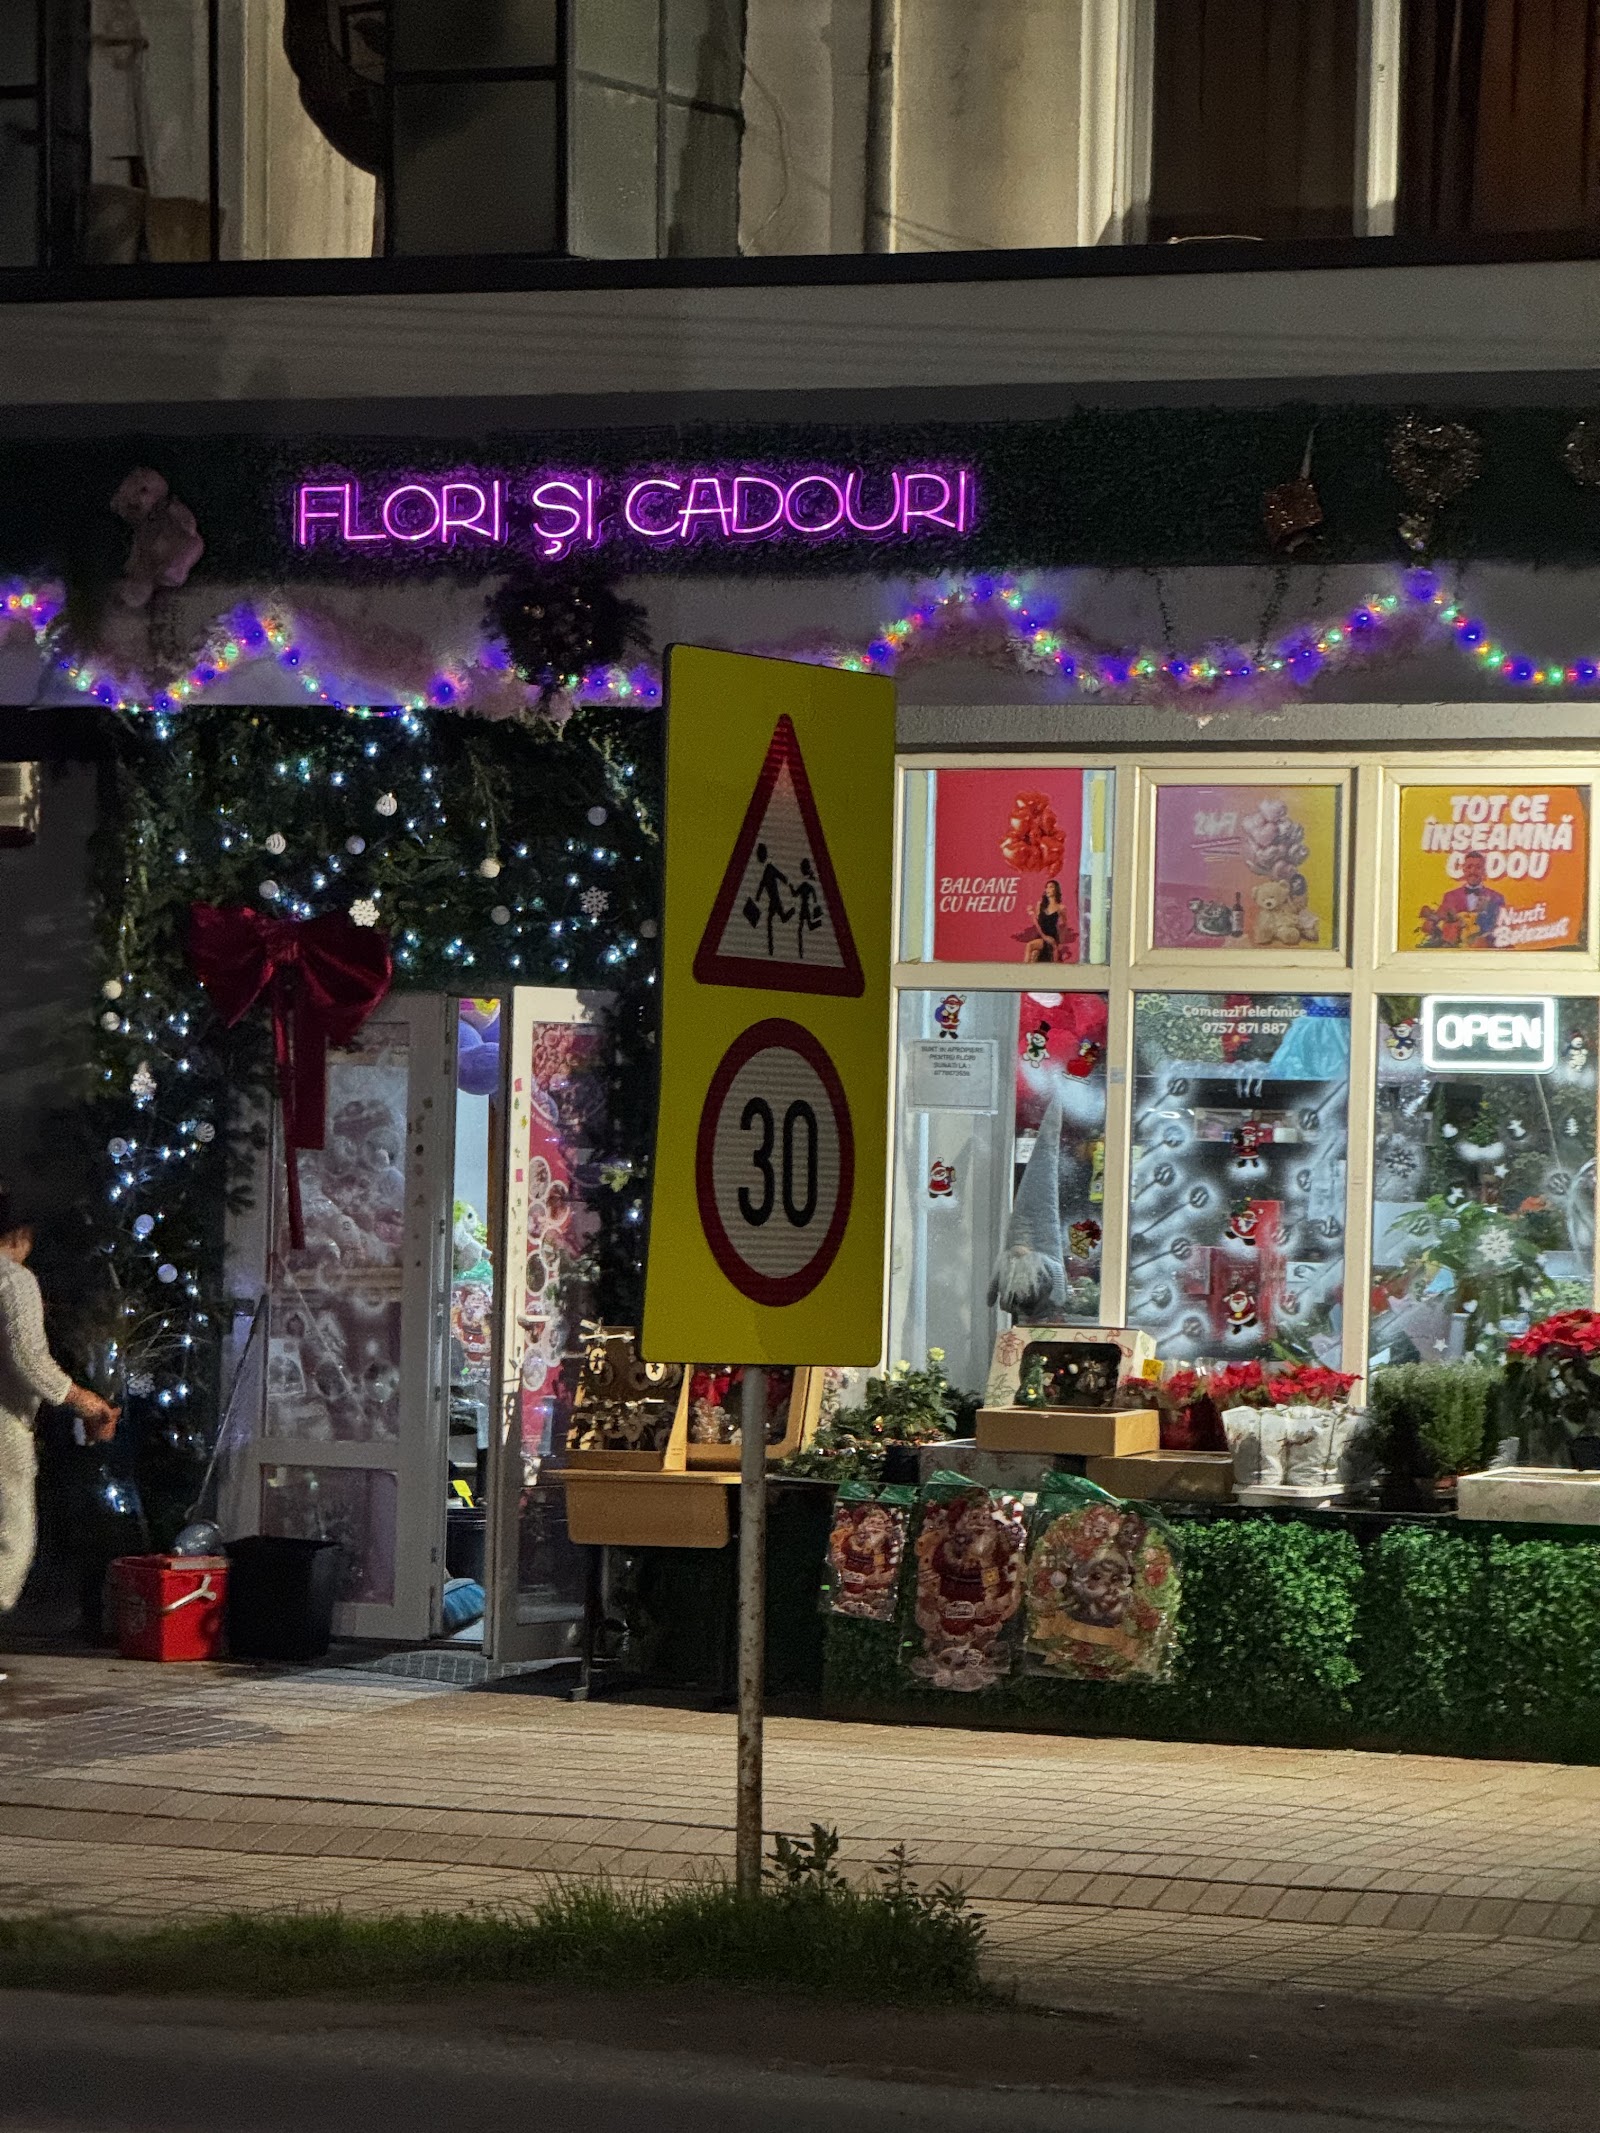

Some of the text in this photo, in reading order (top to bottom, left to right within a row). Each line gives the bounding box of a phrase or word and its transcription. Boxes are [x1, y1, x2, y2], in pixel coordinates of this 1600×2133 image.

[300, 480, 500, 545] FLORI
[625, 470, 966, 537] CADOURI
[1450, 794, 1550, 823] TOT CE
[1420, 814, 1574, 851] ÎNSEAMNĂ
[1446, 851, 1550, 880] CDOU
[940, 877, 1020, 894] BALOANE
[940, 895, 1017, 912] CU HELIU
[1182, 1004, 1308, 1018] Comenzi Telefonice
[1201, 1022, 1288, 1034] 0757 871 887
[1436, 1013, 1543, 1050] OPEN
[738, 1097, 818, 1228] 30
